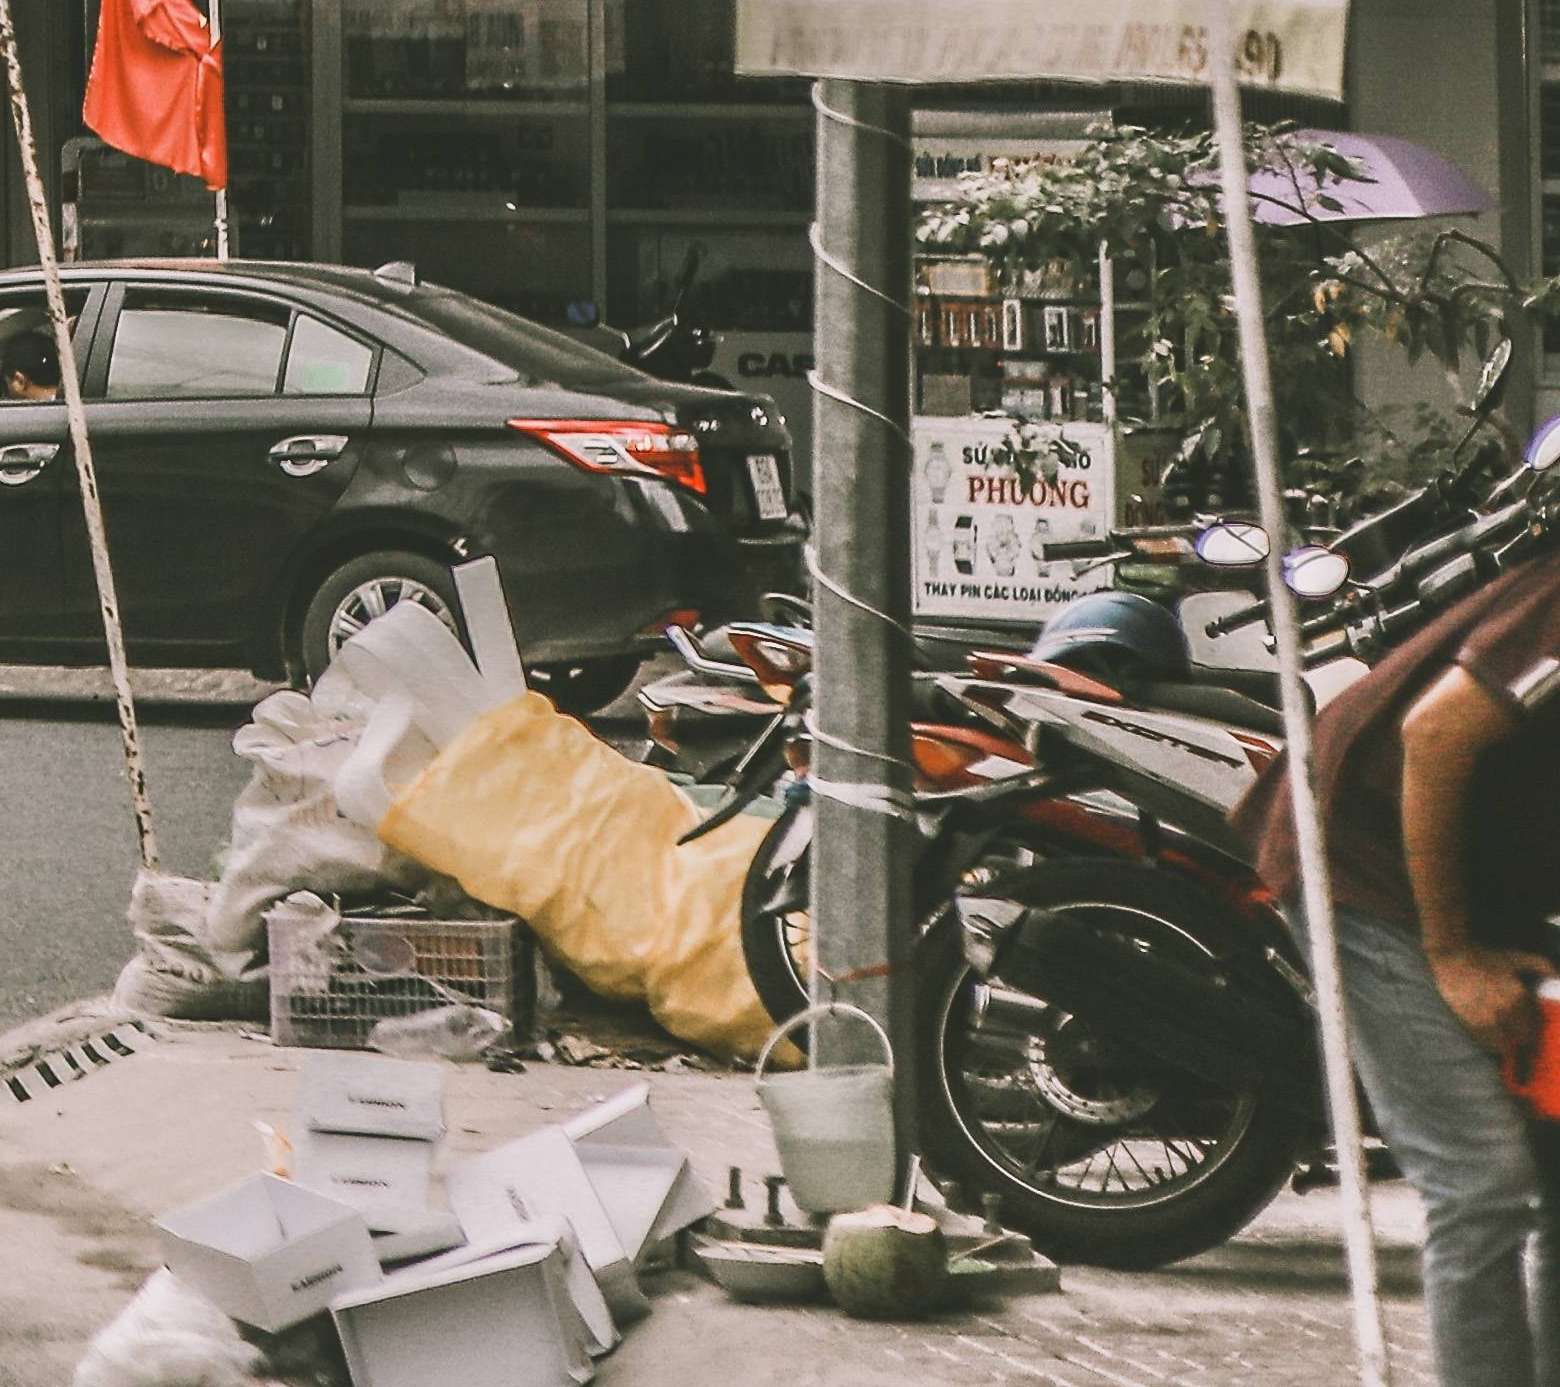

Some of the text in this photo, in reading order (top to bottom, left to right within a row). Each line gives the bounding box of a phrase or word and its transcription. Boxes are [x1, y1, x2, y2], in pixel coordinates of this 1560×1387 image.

[738, 351, 815, 378] CAS
[925, 581, 956, 598] THAY
[961, 583, 981, 599] PIN
